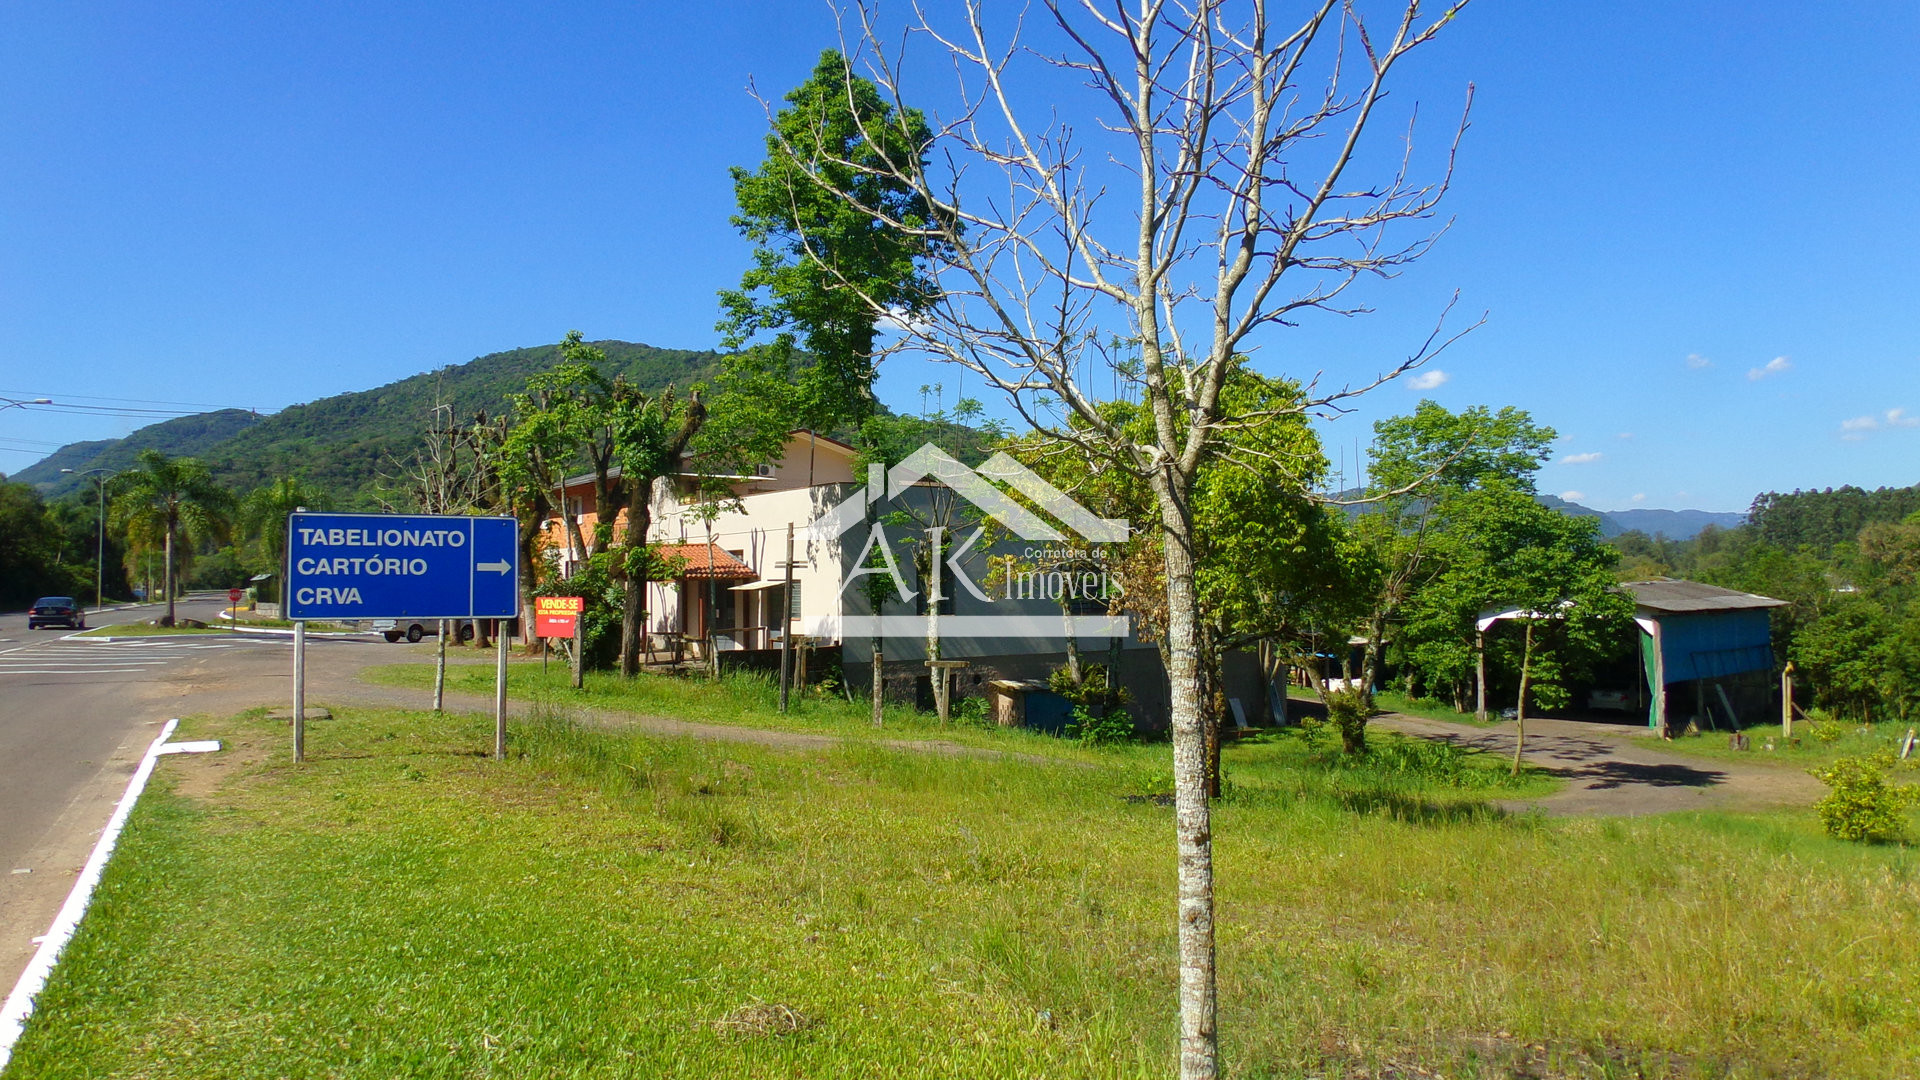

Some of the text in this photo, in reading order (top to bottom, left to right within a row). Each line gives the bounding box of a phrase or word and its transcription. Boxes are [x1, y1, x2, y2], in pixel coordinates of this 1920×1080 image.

[299, 528, 465, 548] TABELIONATO
[297, 554, 428, 576] CARTÓRIO
[297, 587, 363, 606] CRVA
[540, 599, 579, 610] VENDE-SE
